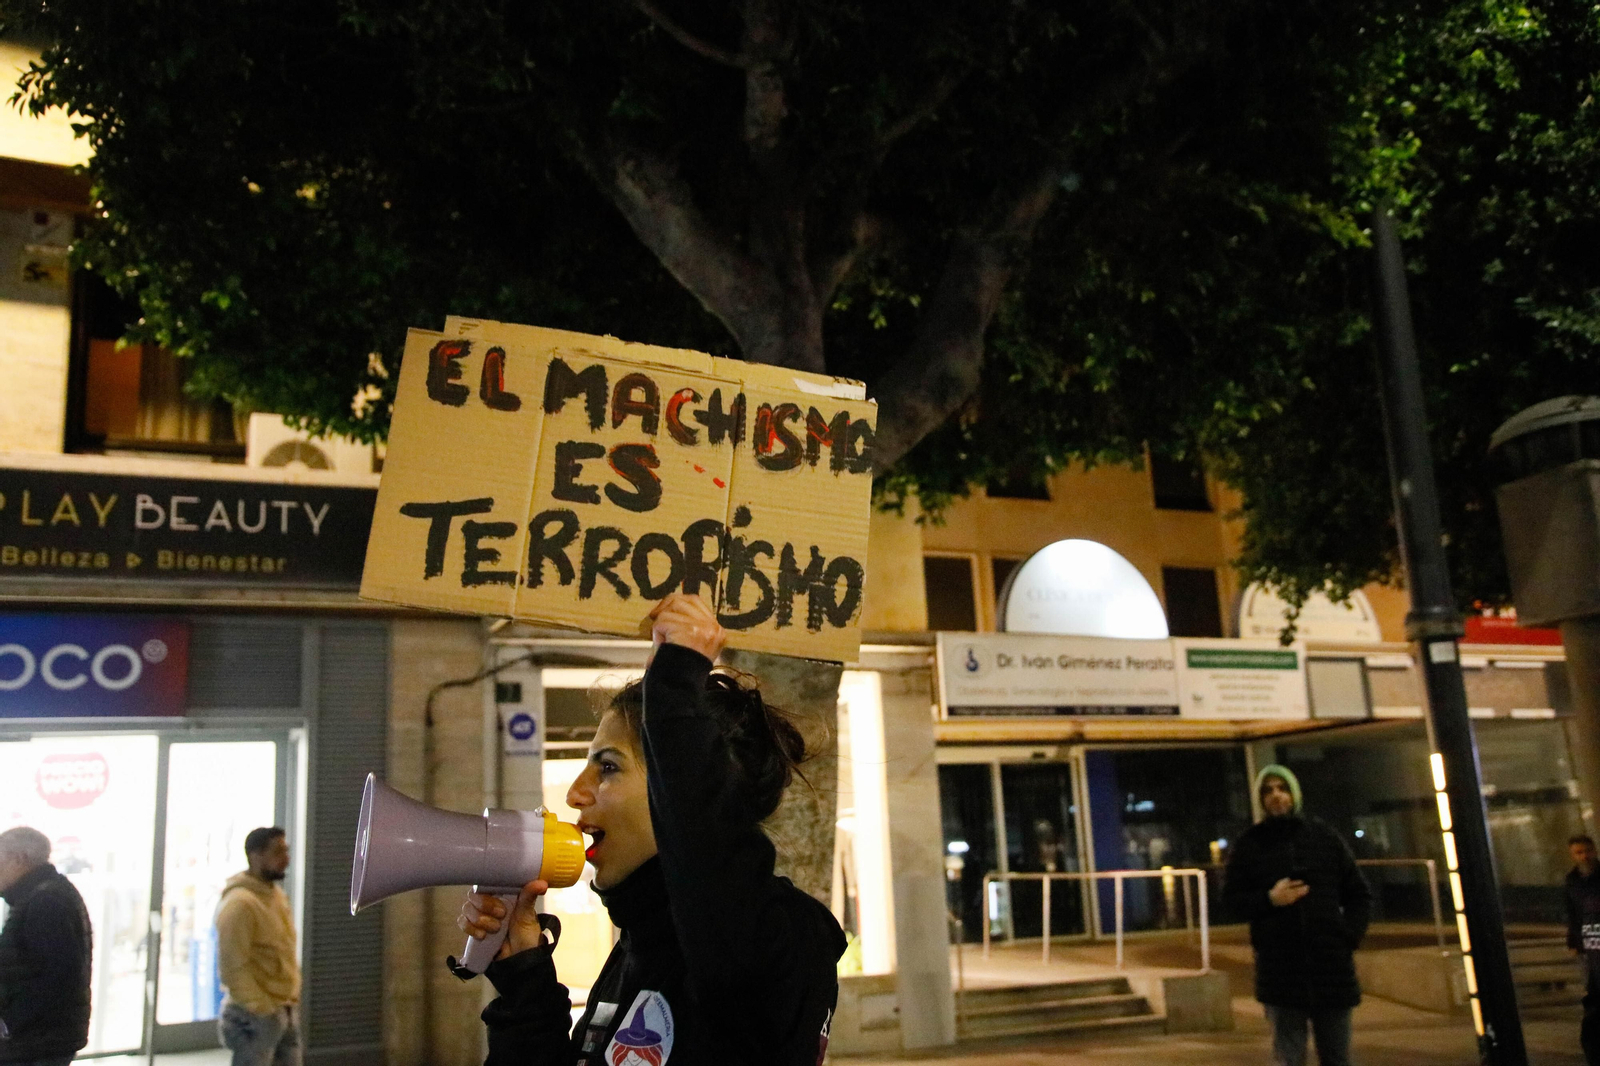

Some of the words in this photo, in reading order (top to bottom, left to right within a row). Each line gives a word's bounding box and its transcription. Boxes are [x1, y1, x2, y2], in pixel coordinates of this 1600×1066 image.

[426, 339, 522, 412] EL
[543, 356, 877, 475] MACHISMO
[551, 440, 662, 513] ES
[0, 489, 118, 527] LAY
[134, 494, 330, 535] BEAUTY
[1, 546, 110, 569] Belleza
[157, 550, 288, 574] Bienestar
